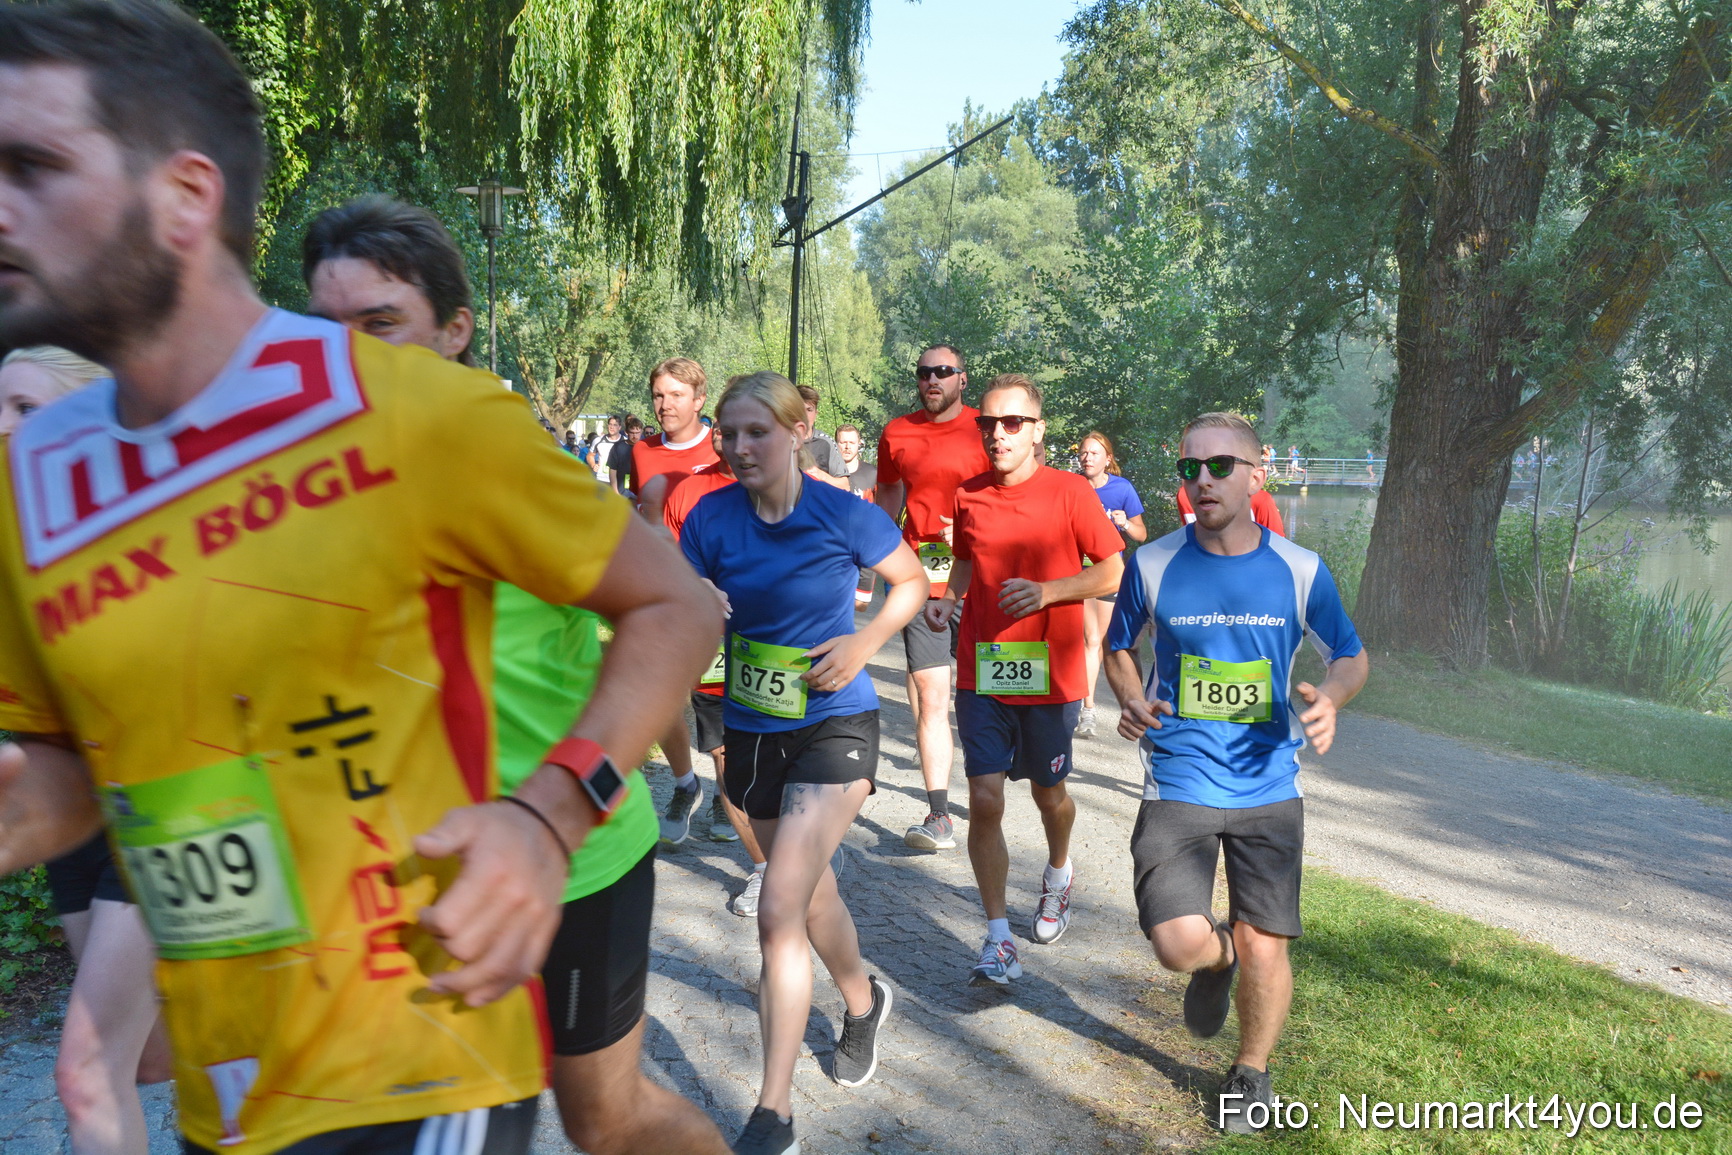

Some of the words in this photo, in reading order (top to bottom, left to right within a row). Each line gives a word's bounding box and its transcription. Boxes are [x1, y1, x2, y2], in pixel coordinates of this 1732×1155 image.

[34, 535, 180, 647] MAX
[193, 445, 398, 559] BÖGL
[930, 556, 951, 571] 23
[1169, 611, 1286, 627] energiegeladen
[741, 663, 785, 696] 675
[991, 661, 1033, 680] 238
[775, 697, 795, 707] Katja
[1192, 680, 1259, 705] 1803
